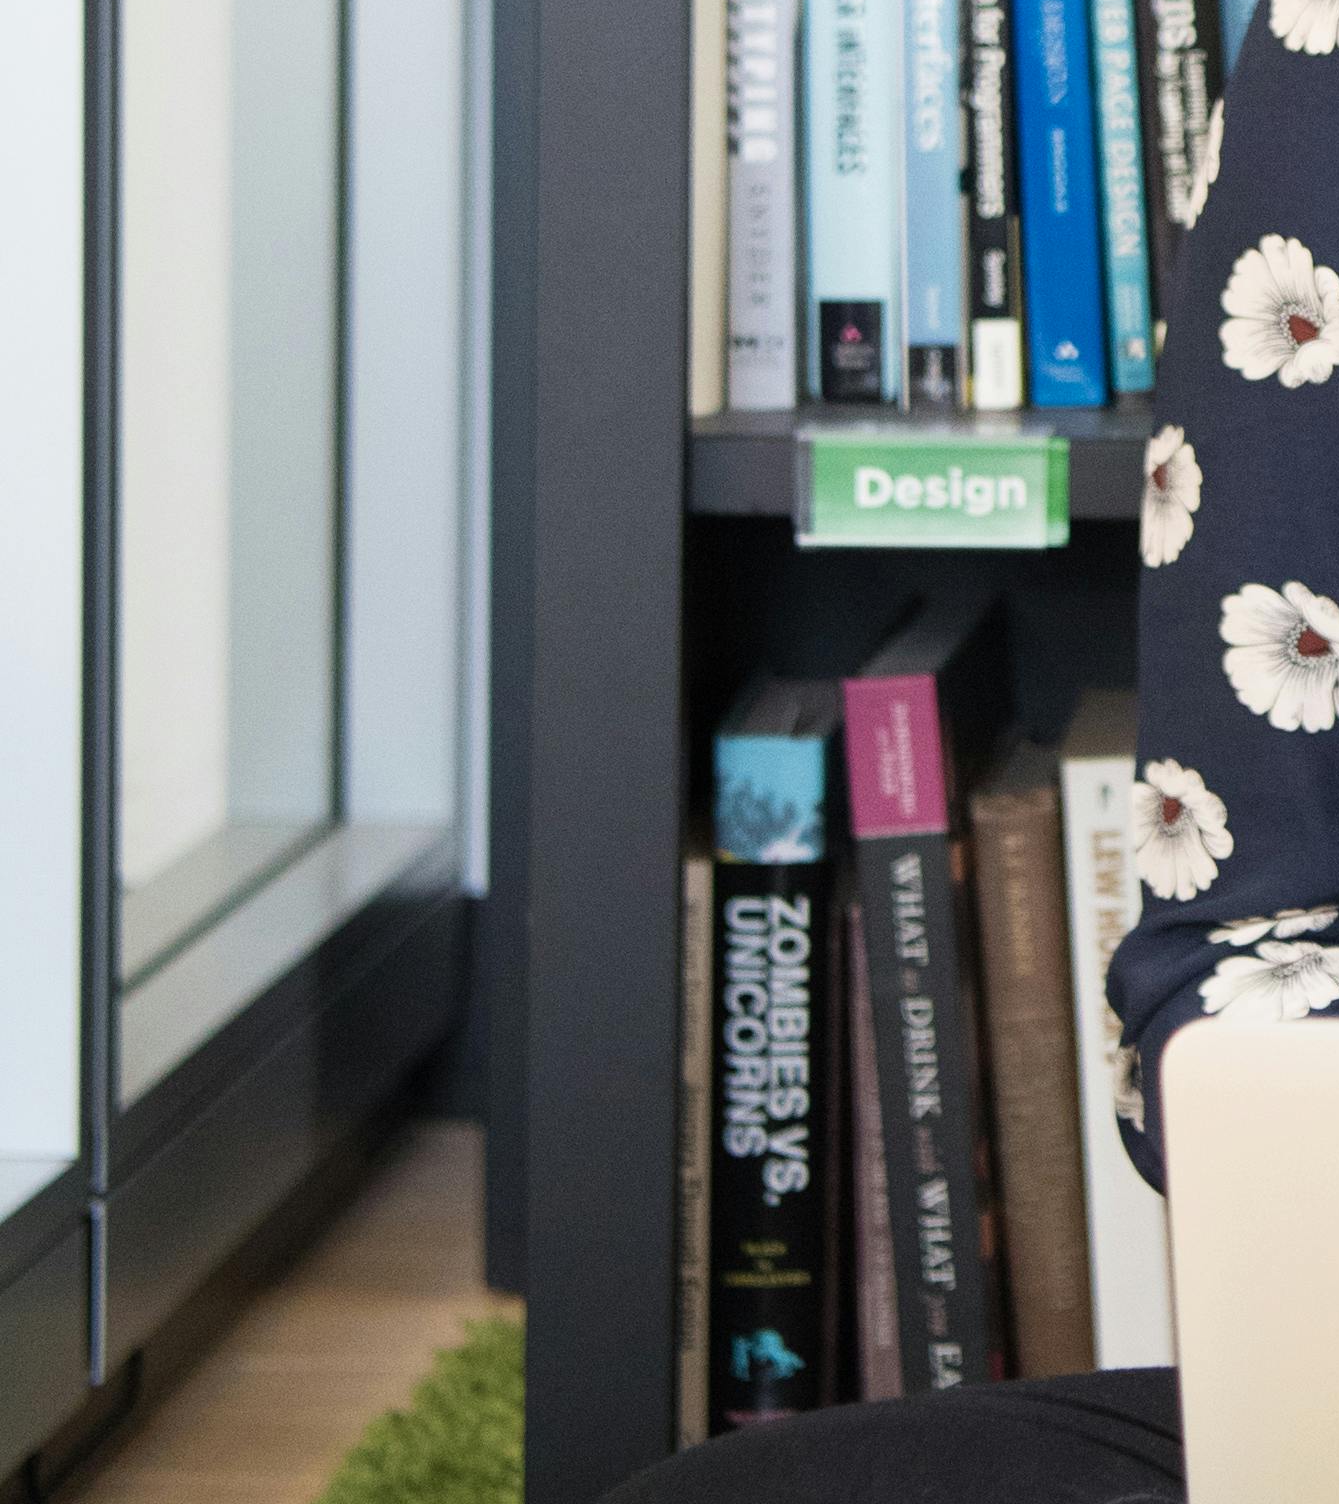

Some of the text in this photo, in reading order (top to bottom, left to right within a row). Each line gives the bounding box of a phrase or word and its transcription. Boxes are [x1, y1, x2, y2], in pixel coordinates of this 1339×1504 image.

[972, 6, 1006, 42] for
[972, 45, 1009, 219] Programmers
[1108, 138, 1142, 258] DESIGN
[853, 465, 1028, 517] Design
[888, 853, 929, 967] WHAT
[723, 896, 768, 1159] UNICORNS
[761, 896, 811, 1206] ZOMBIES VS.
[901, 995, 942, 1121] DRINK
[915, 1178, 956, 1291] WHAT
[931, 1341, 965, 1390] EA
